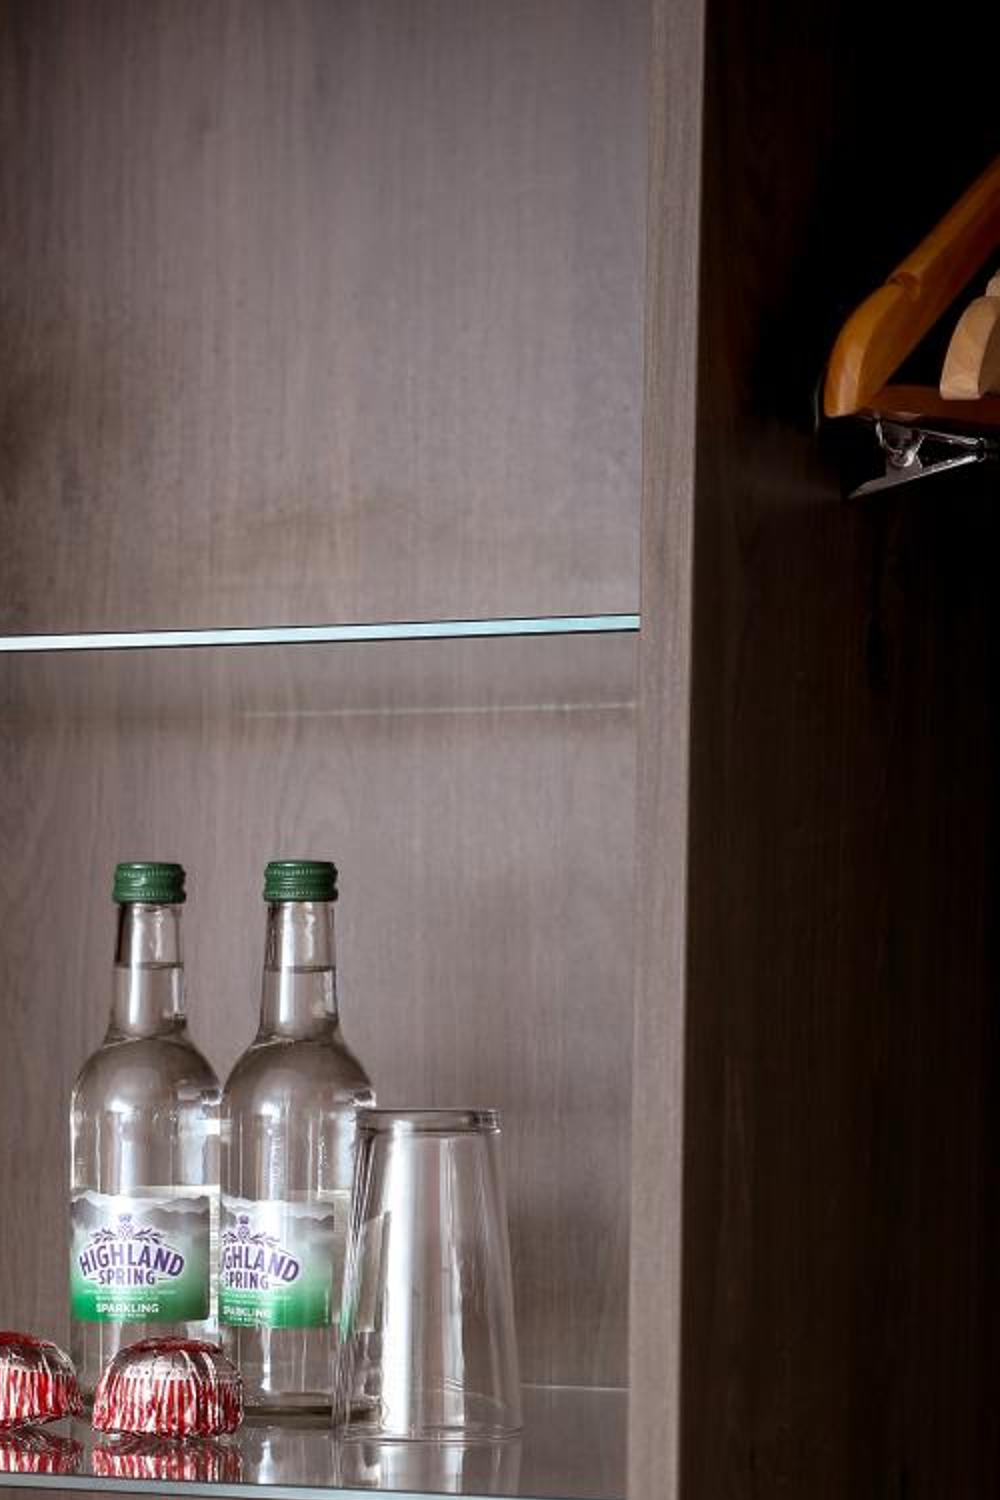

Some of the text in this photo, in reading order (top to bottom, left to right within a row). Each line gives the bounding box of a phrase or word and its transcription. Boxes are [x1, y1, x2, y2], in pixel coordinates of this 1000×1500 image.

[79, 1243, 185, 1276] HIGHLAND
[98, 1266, 156, 1286] SPRING
[96, 1303, 159, 1313] SPARKLING
